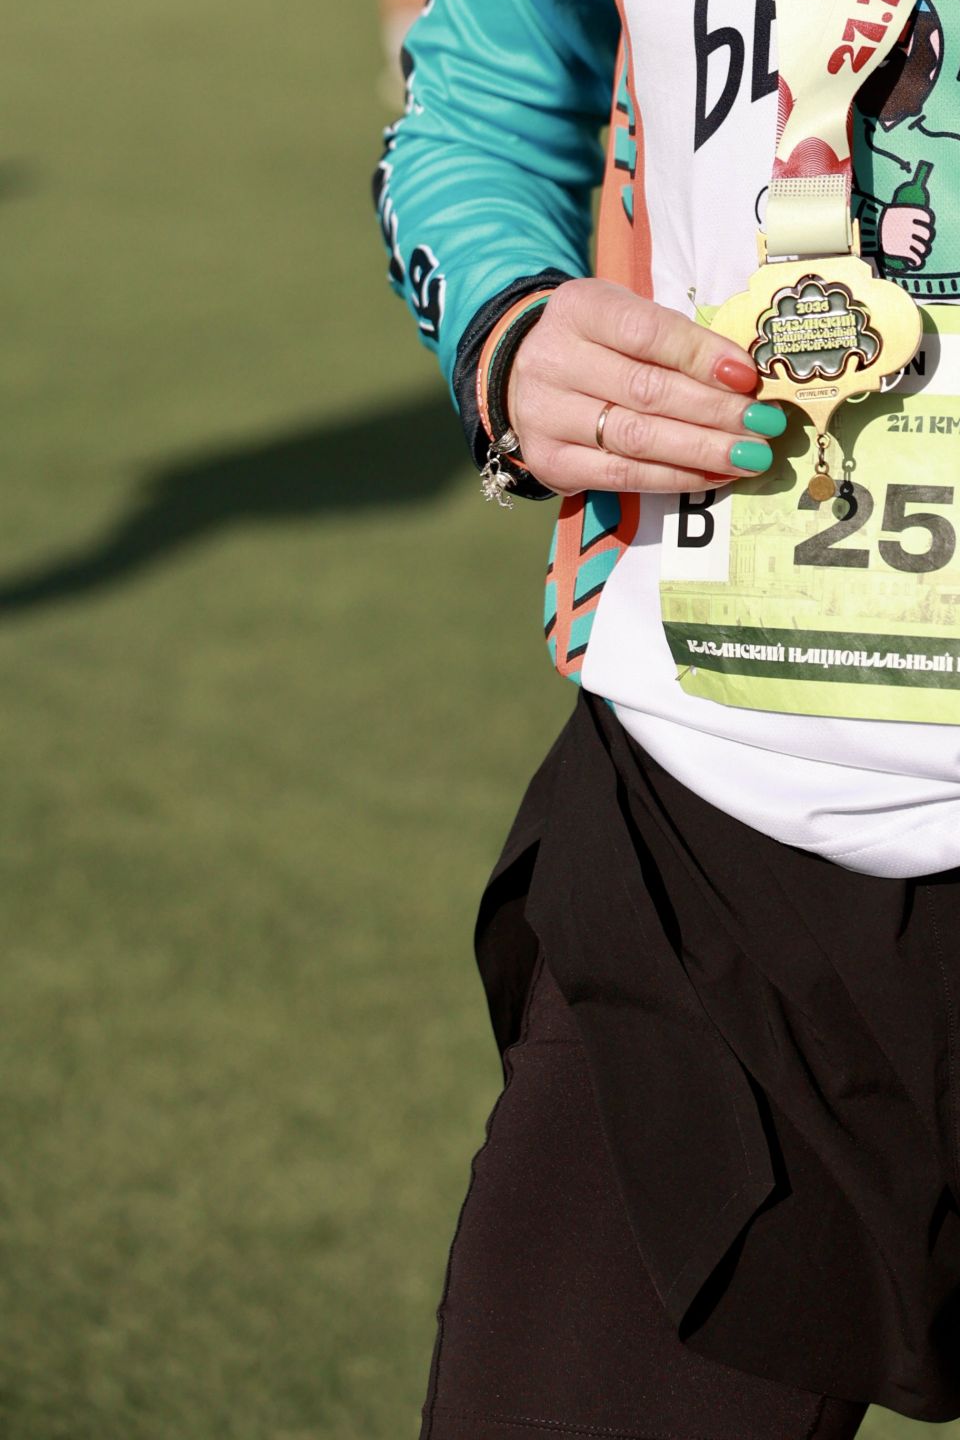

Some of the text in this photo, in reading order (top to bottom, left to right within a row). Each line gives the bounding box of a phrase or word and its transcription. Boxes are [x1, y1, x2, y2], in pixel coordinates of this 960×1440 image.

[796, 299, 830, 314] 2026
[771, 313, 857, 334] КАЗАНСКИЙ
[887, 414, 923, 434] 21.1
[686, 639, 785, 662] КАЗАНСКИЙ
[788, 647, 954, 672] НАЦИОНАЛЬНЫЙ
